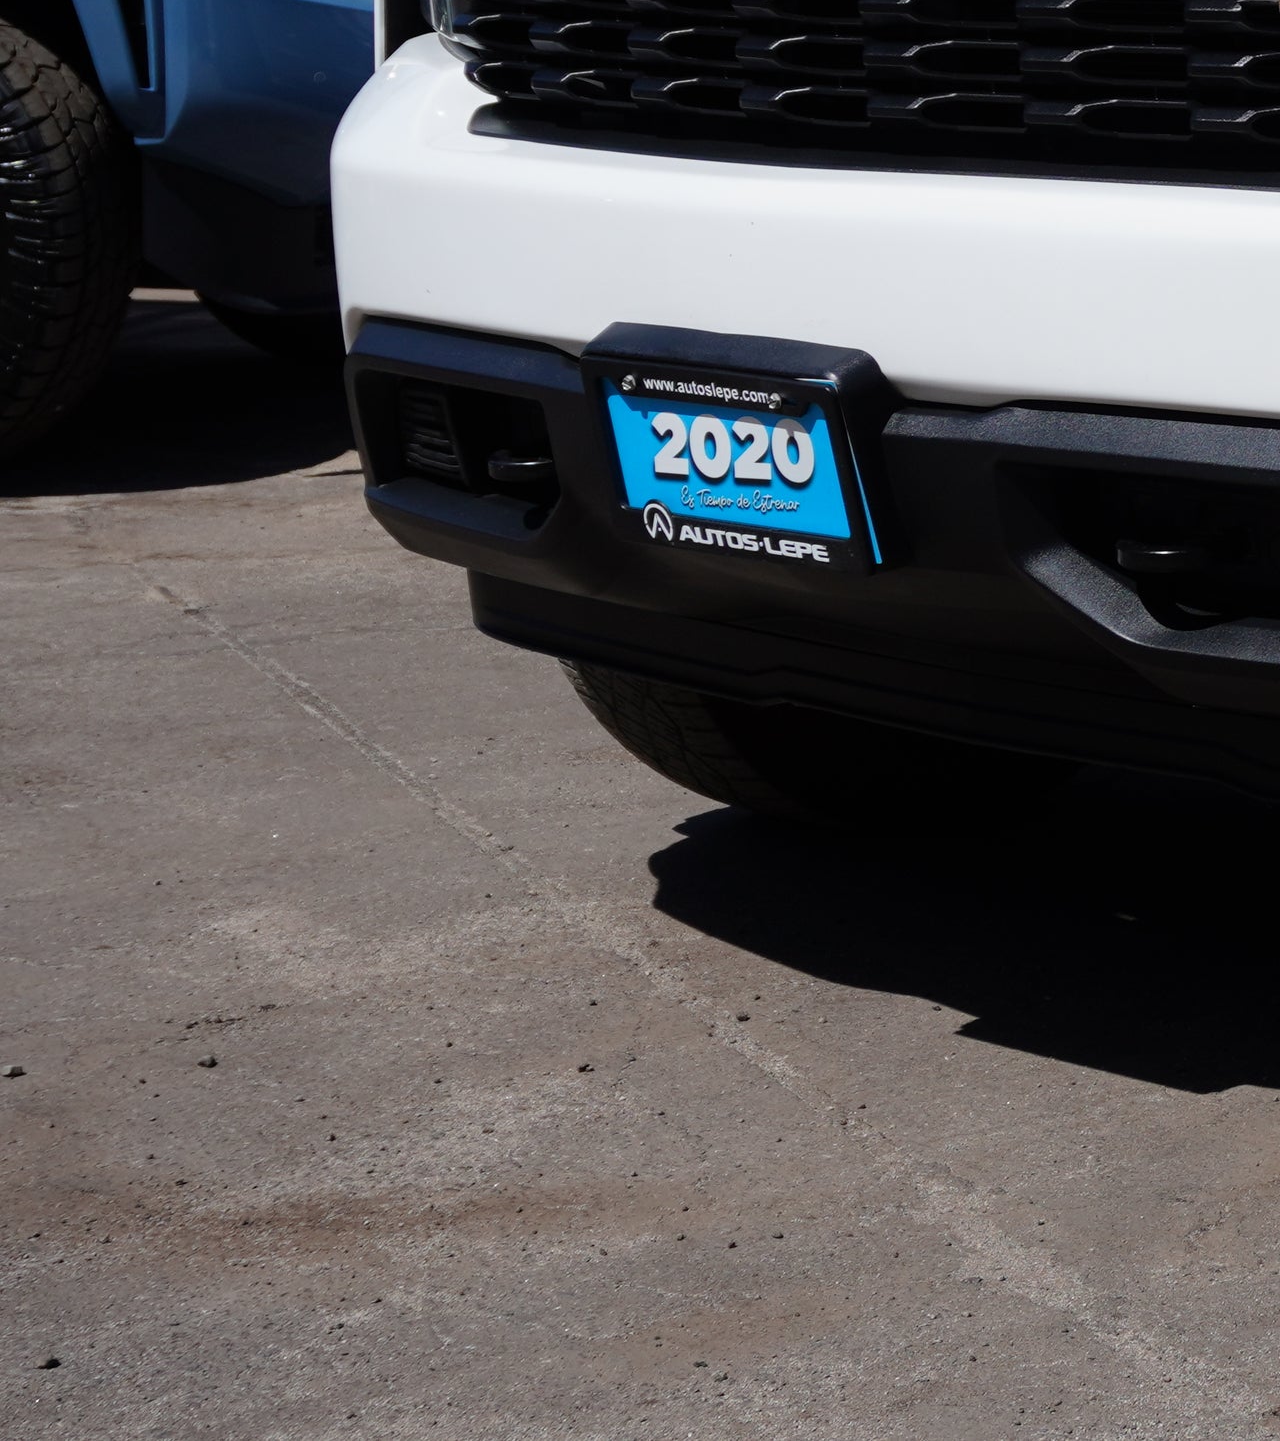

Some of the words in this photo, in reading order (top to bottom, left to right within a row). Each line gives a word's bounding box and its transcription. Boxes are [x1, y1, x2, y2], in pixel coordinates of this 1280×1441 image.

[643, 378, 770, 404] www.autoslepe.com
[651, 412, 815, 484] 2020
[681, 485, 695, 508] Es
[697, 488, 734, 509] Tiempo
[736, 493, 750, 509] de
[752, 489, 800, 513] Estrenar
